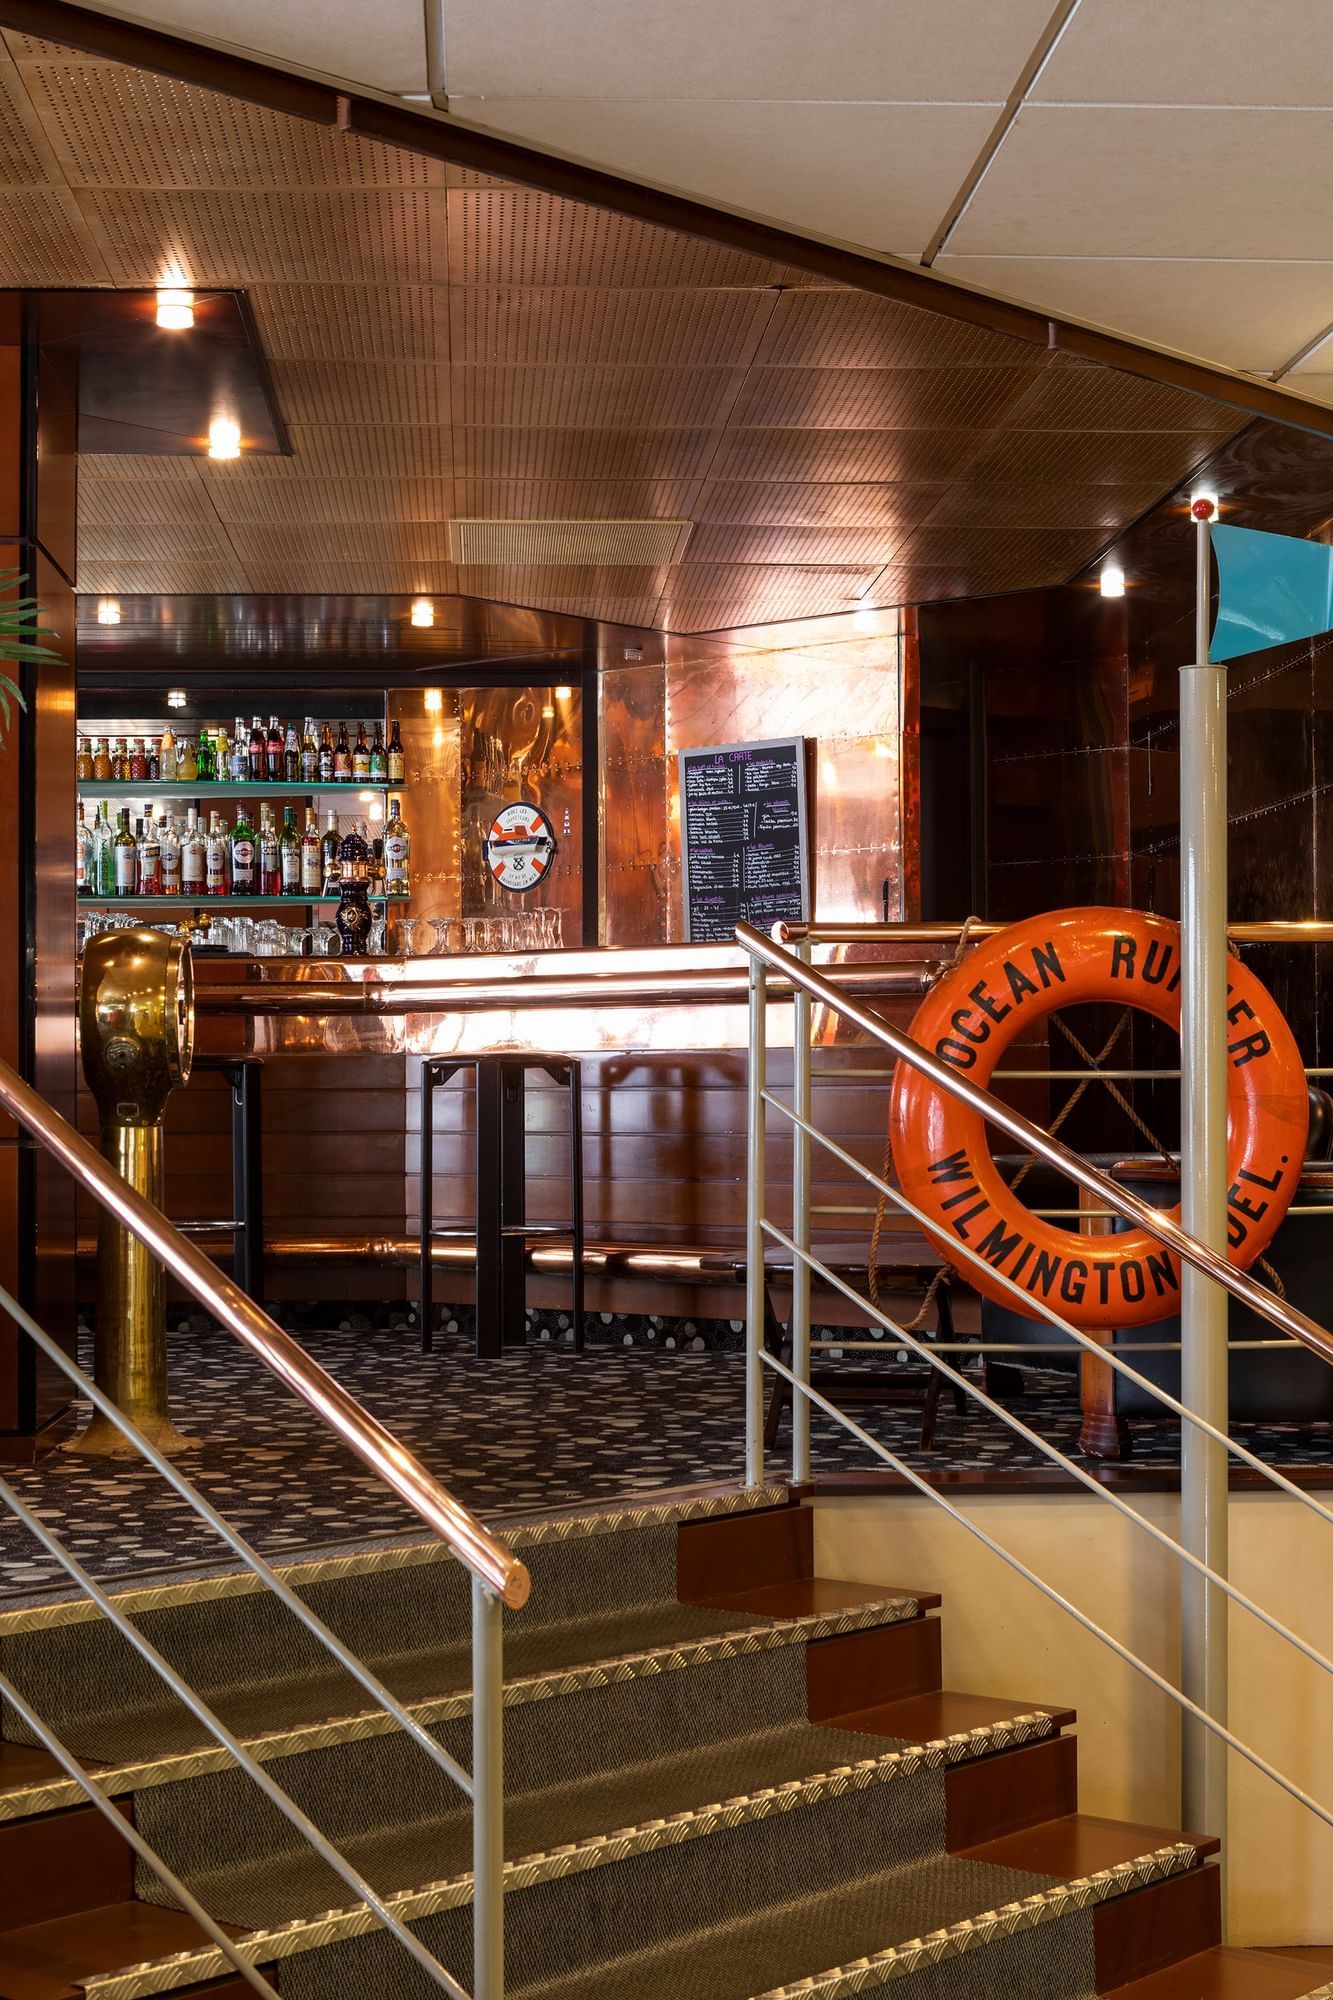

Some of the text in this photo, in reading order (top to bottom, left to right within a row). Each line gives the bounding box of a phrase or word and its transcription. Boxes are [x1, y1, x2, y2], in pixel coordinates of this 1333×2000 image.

[714, 751, 753, 765] LA CARTE
[936, 936, 1270, 1069] OCEAN RUER
[928, 1151, 1179, 1304] WILMINGTON
